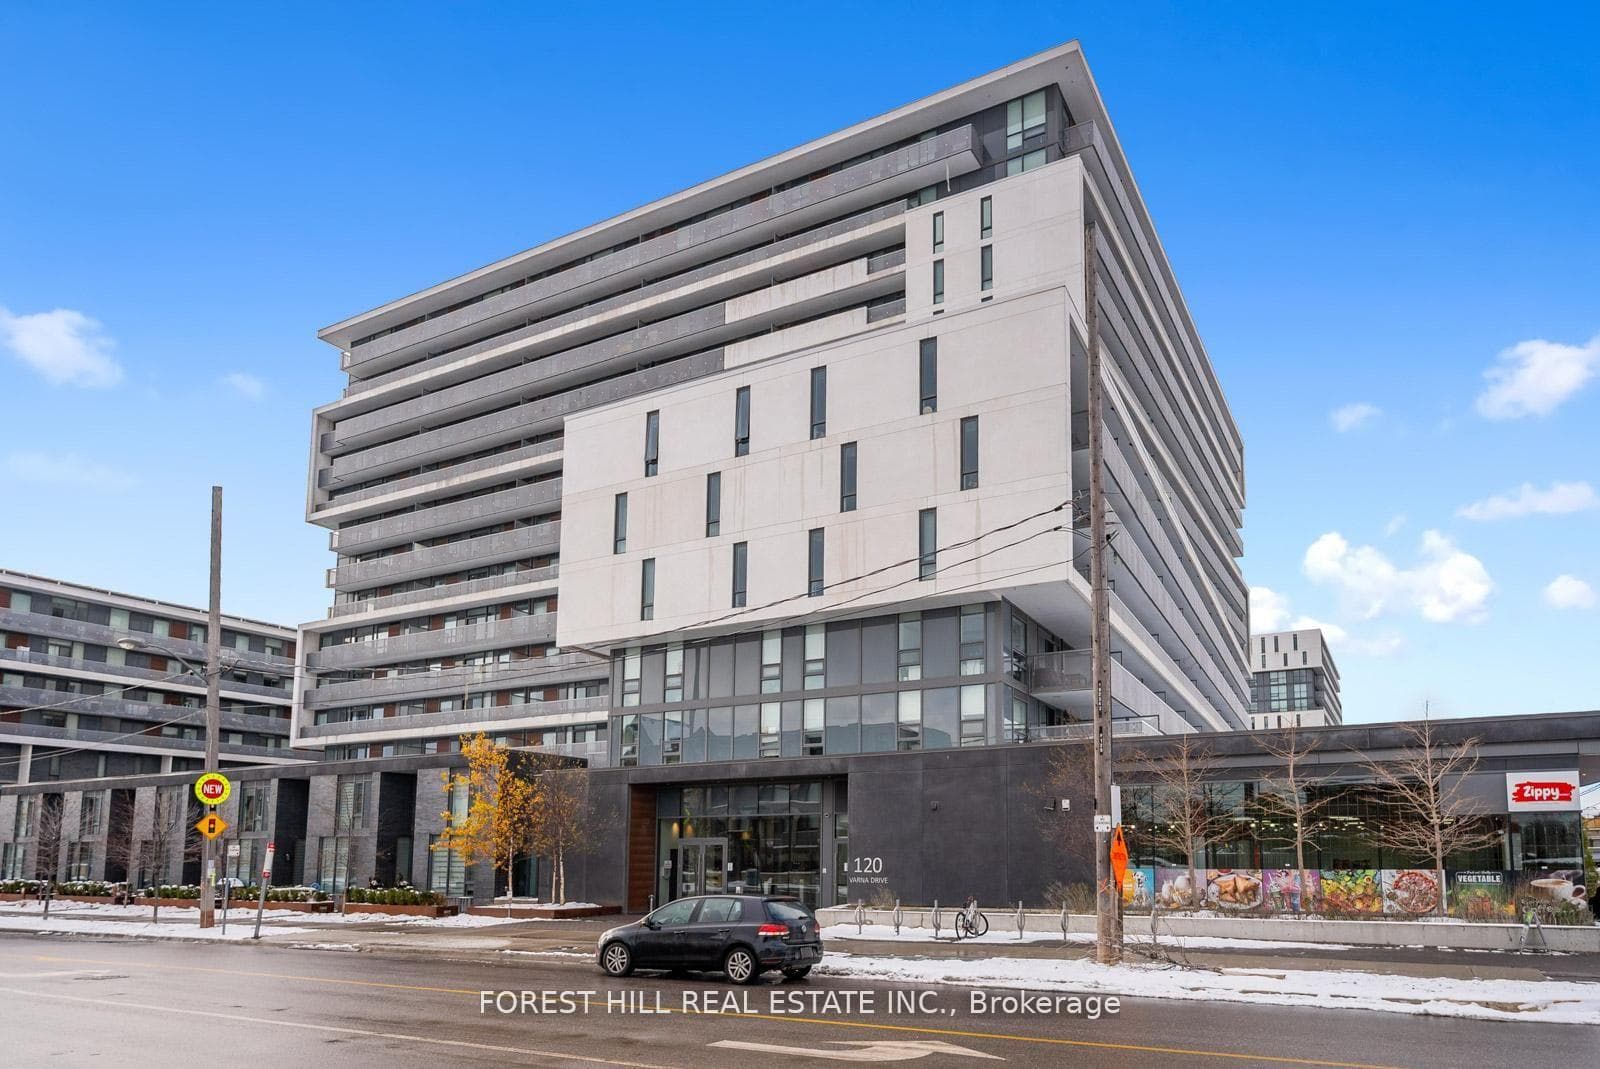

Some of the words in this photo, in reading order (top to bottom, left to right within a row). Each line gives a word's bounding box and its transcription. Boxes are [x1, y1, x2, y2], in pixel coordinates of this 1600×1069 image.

[203, 784, 223, 794] NEW
[1523, 785, 1560, 800] Zippy
[854, 857, 883, 873] 120
[1457, 875, 1501, 883] VEGETABLE
